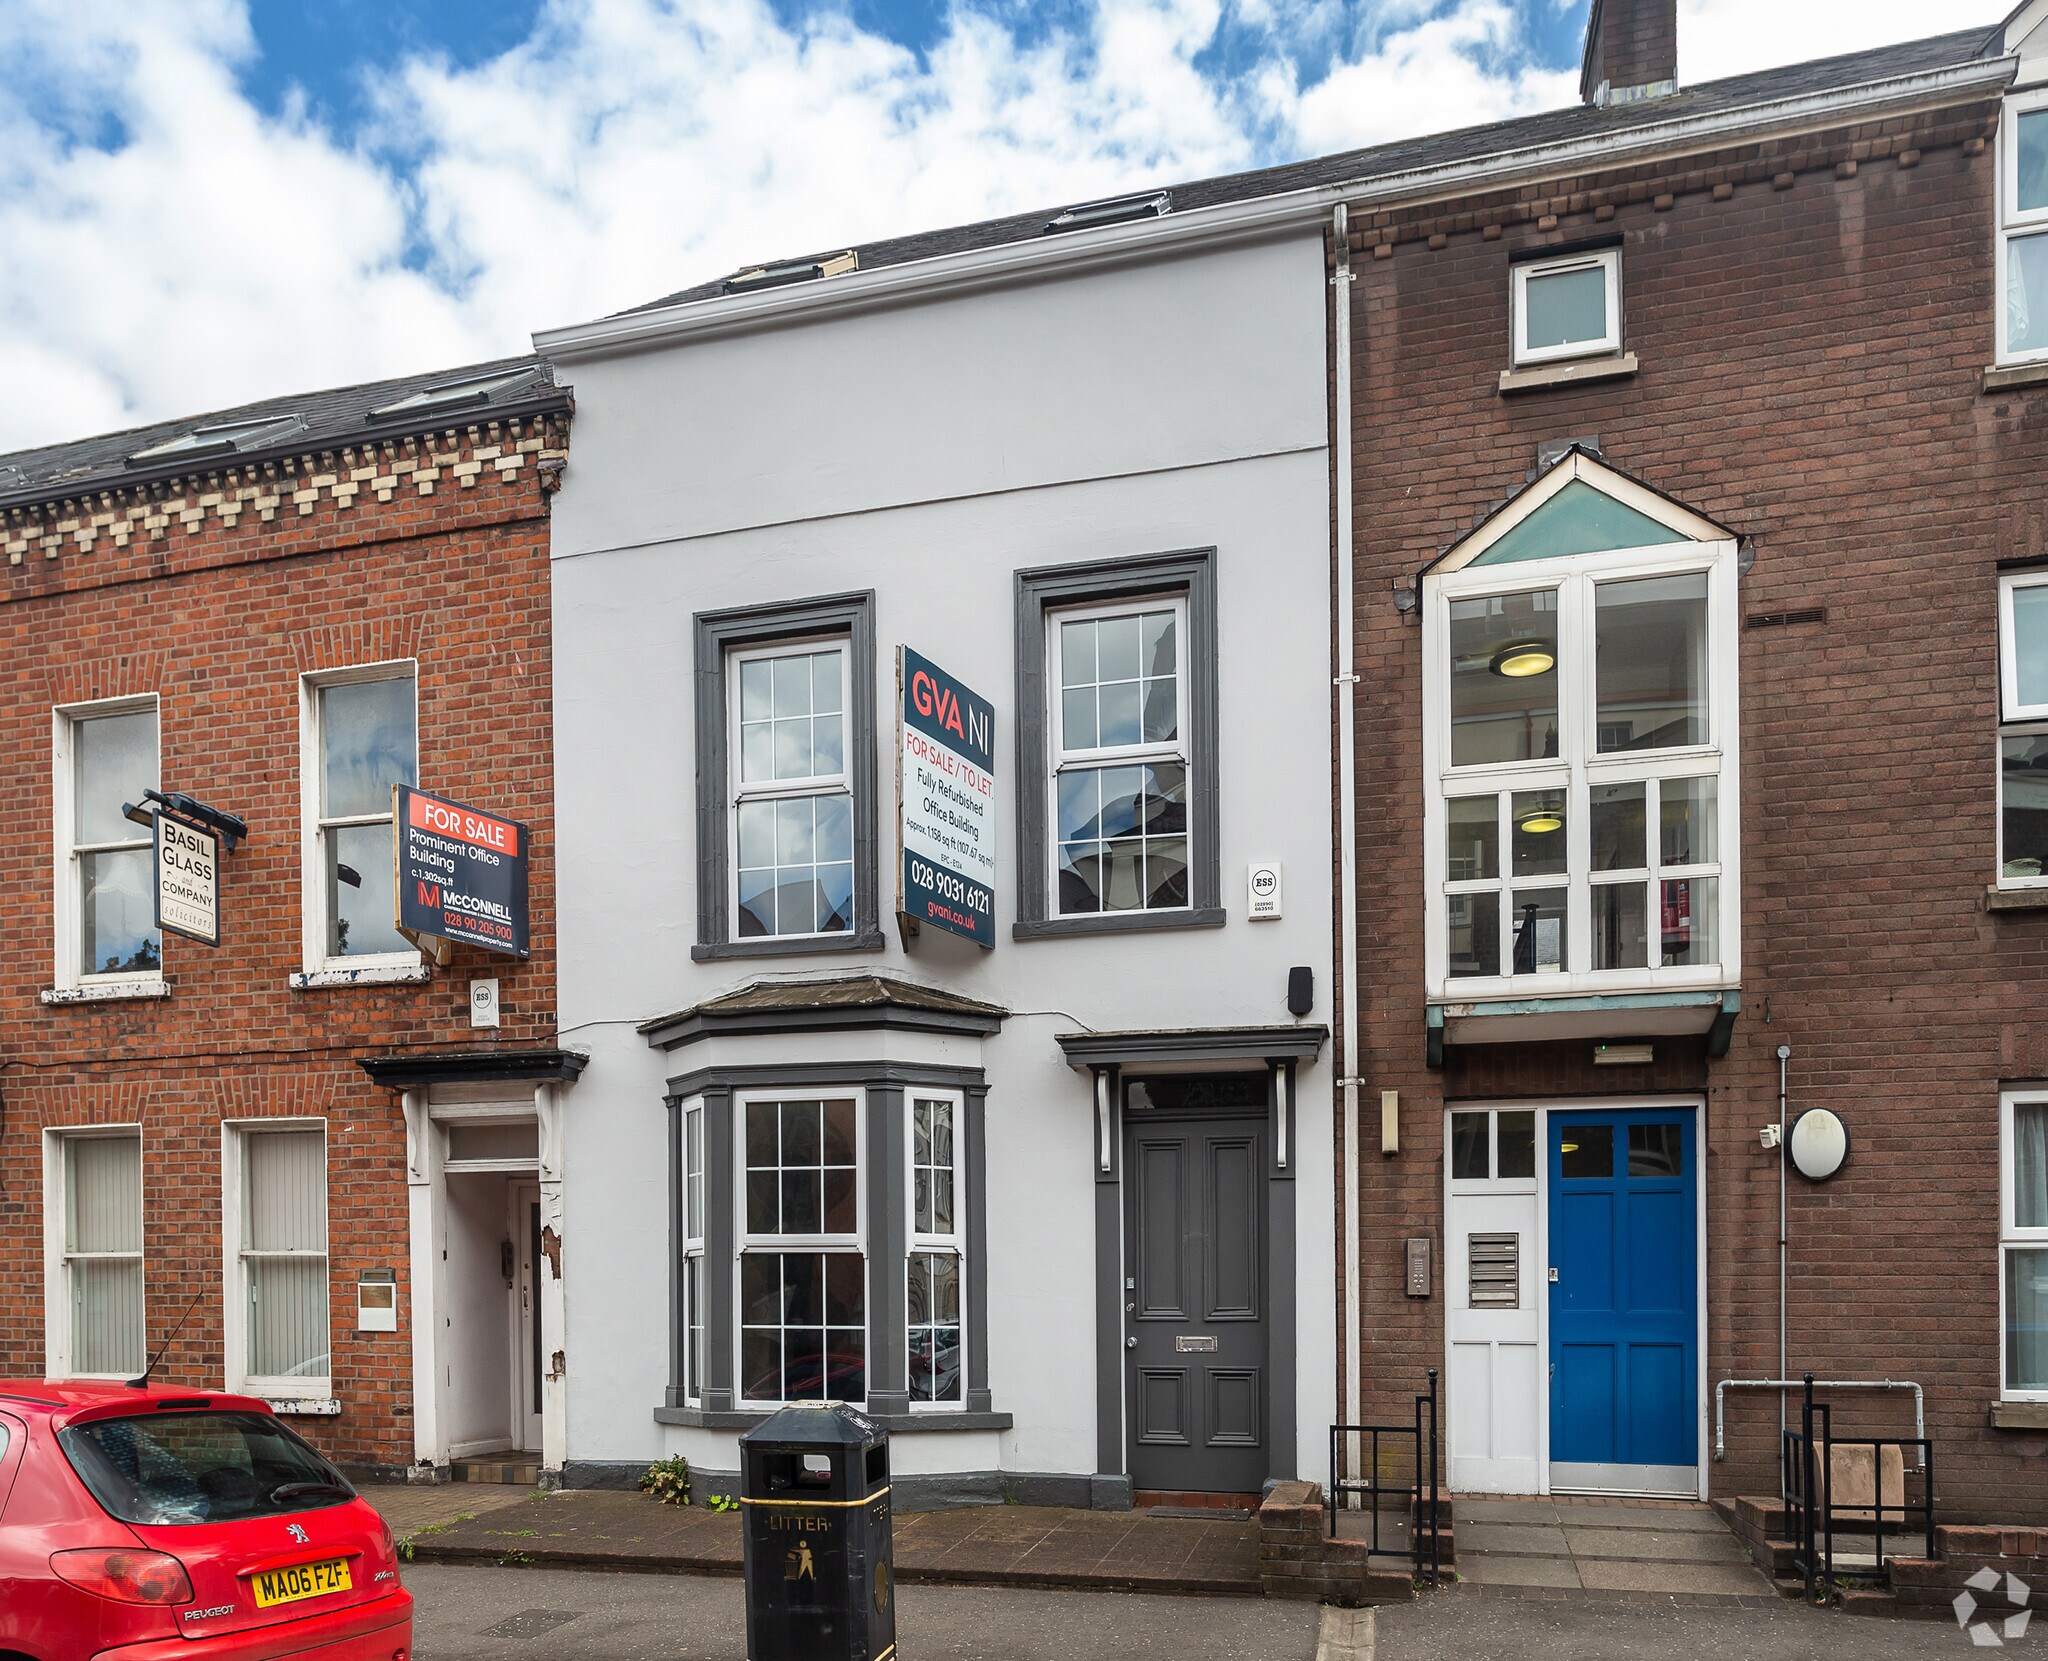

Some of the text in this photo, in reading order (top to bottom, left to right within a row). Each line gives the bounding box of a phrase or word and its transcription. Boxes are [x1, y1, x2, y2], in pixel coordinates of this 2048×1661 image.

[912, 670, 988, 756] GVA NI
[906, 732, 928, 761] FOR
[929, 744, 954, 776] SALE
[962, 764, 976, 788] TO
[977, 774, 993, 798] LET
[917, 767, 983, 817] Fully Refurbished
[425, 803, 505, 848] FOR SALE
[923, 797, 979, 842] Office Building
[164, 823, 210, 858] BASIL
[409, 828, 500, 866] Prominent Office
[906, 817, 927, 835] Approx.
[927, 825, 941, 843] 1,158
[942, 835, 950, 850] sq
[950, 836, 957, 850] ft
[978, 853, 986, 867] sq
[162, 846, 212, 880] GLASS
[409, 845, 455, 873] Building
[940, 853, 950, 865] EPC
[162, 880, 213, 907] COMPANY
[181, 877, 193, 887] and
[417, 880, 440, 910] M
[911, 859, 989, 915] 028 9031 6121
[1256, 877, 1273, 887] ESS
[164, 906, 212, 930] solicitors
[444, 911, 512, 941] 028 90 205 900
[927, 901, 976, 931] gvani.co.uk
[444, 927, 513, 949] www.mcconnellproperty.com
[476, 993, 489, 1001] ESS
[770, 1515, 828, 1532] LITTER
[260, 1567, 312, 1601] MA06
[314, 1562, 343, 1590] FZF
[184, 1604, 235, 1621] PEUGEOT
